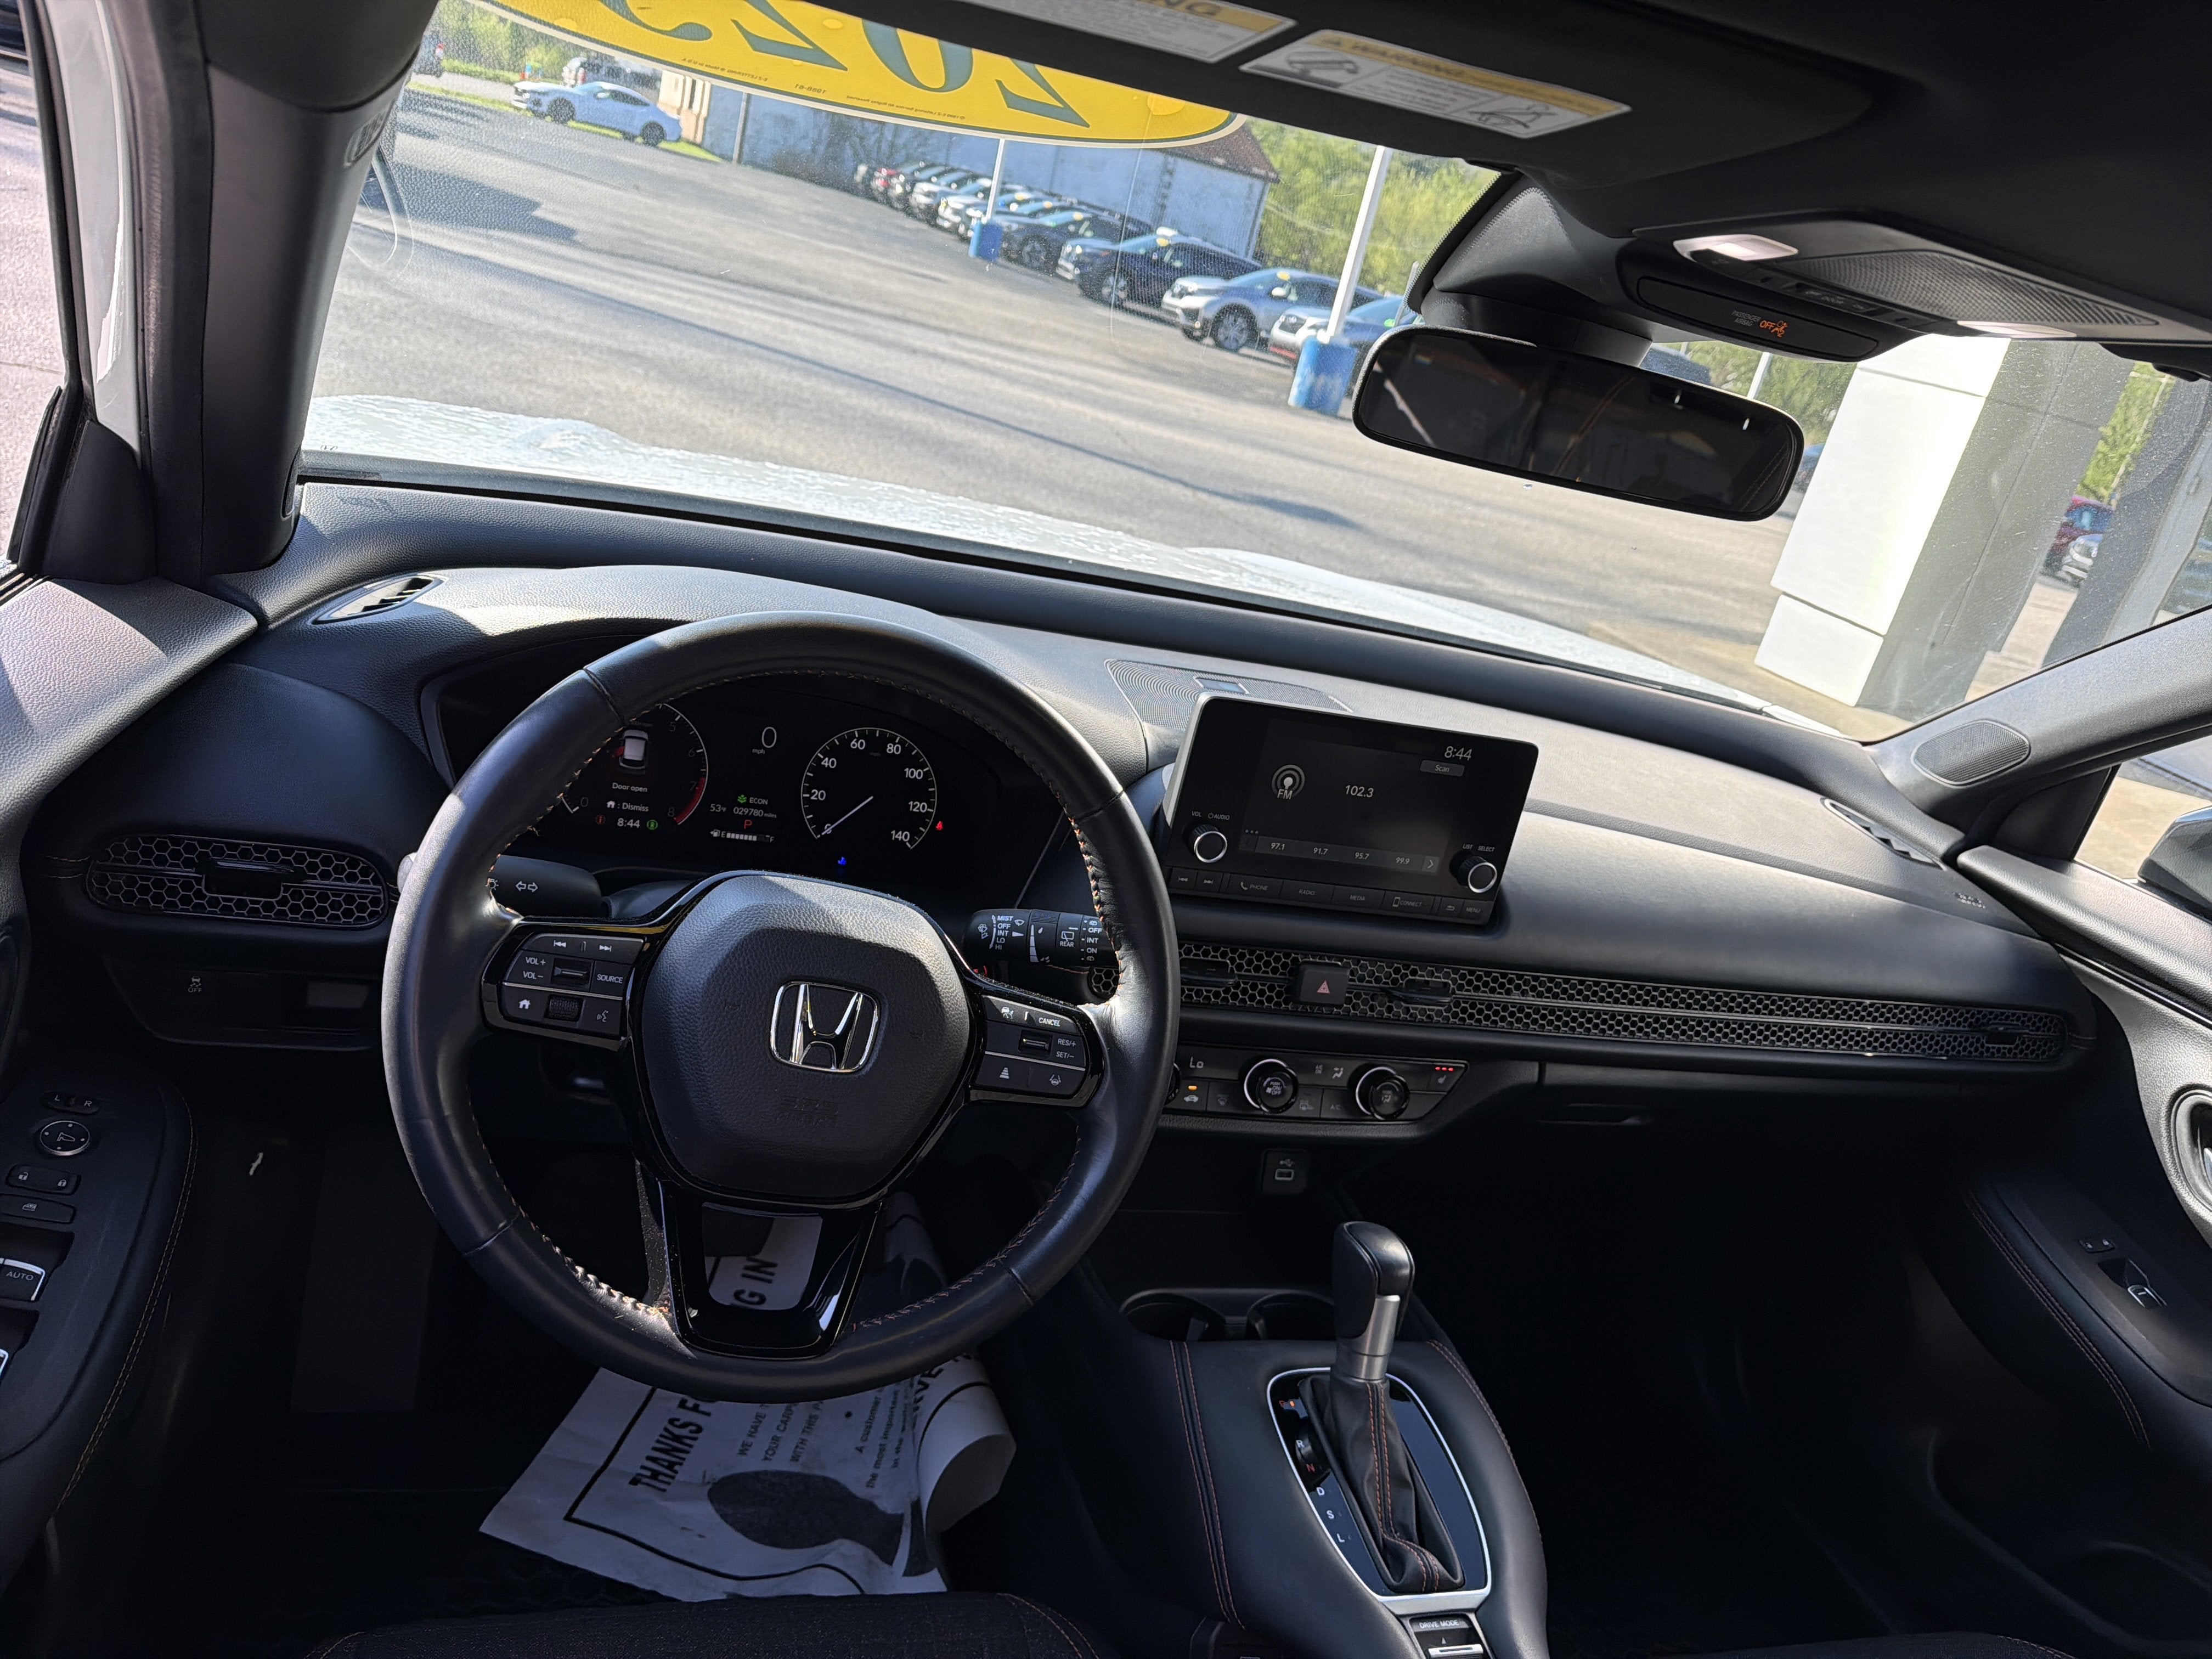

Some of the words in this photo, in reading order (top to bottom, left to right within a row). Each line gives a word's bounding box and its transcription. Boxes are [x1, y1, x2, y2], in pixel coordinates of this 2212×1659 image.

[1731, 310, 1761, 322] PASSENGER
[1734, 318, 1754, 327] AIRBAG
[1759, 320, 1776, 330] OFF
[669, 723, 676, 732] 5
[761, 726, 777, 748] 0
[850, 738, 866, 750] 60
[886, 743, 901, 755] 80
[688, 749, 696, 758] 6
[1444, 746, 1472, 761] 8:44
[821, 757, 837, 769] 40
[1435, 764, 1450, 773] Scan
[904, 768, 923, 780] 100
[612, 782, 629, 791] Door
[630, 785, 648, 793] open
[690, 780, 697, 791] 7
[810, 789, 826, 801] 20
[1277, 788, 1293, 800] FM
[1345, 785, 1374, 798] 102.3
[580, 797, 589, 808] 0
[749, 797, 769, 805] ECON
[908, 800, 928, 813] 120
[622, 802, 650, 812] Dismiss
[667, 806, 675, 817] 8
[732, 806, 764, 817] 029780
[616, 817, 641, 829] 8:44
[743, 819, 754, 830] P
[890, 830, 910, 842] 140
[1271, 842, 1285, 850] 97.1
[1313, 847, 1328, 855] 91.7
[1355, 852, 1369, 860] 95.7
[1396, 856, 1410, 865] 99.9
[1400, 899, 1423, 908] CONNECT
[1465, 905, 1481, 913] MENU
[596, 973, 624, 984] SOURCE
[1038, 1017, 1060, 1027] CANCEL
[1057, 1038, 1076, 1047] RES/+
[1189, 1056, 1204, 1068] Lo
[5, 1271, 34, 1281] AUTO
[741, 1257, 778, 1284] IN
[733, 1289, 766, 1306] G
[676, 1396, 712, 1417] F
[860, 1396, 881, 1442] customer
[789, 1437, 809, 1462] WITH
[801, 1413, 820, 1436] THIS
[737, 1440, 754, 1455] WE
[761, 1435, 782, 1462] YOUR
[628, 1417, 703, 1492] THANKS
[865, 1472, 878, 1488] the
[873, 1443, 887, 1469] most
[1306, 1463, 1316, 1472] N
[1316, 1487, 1325, 1497] D
[1327, 1509, 1335, 1520] S
[1336, 1532, 1345, 1543] L
[1440, 1619, 1460, 1627] MODE
